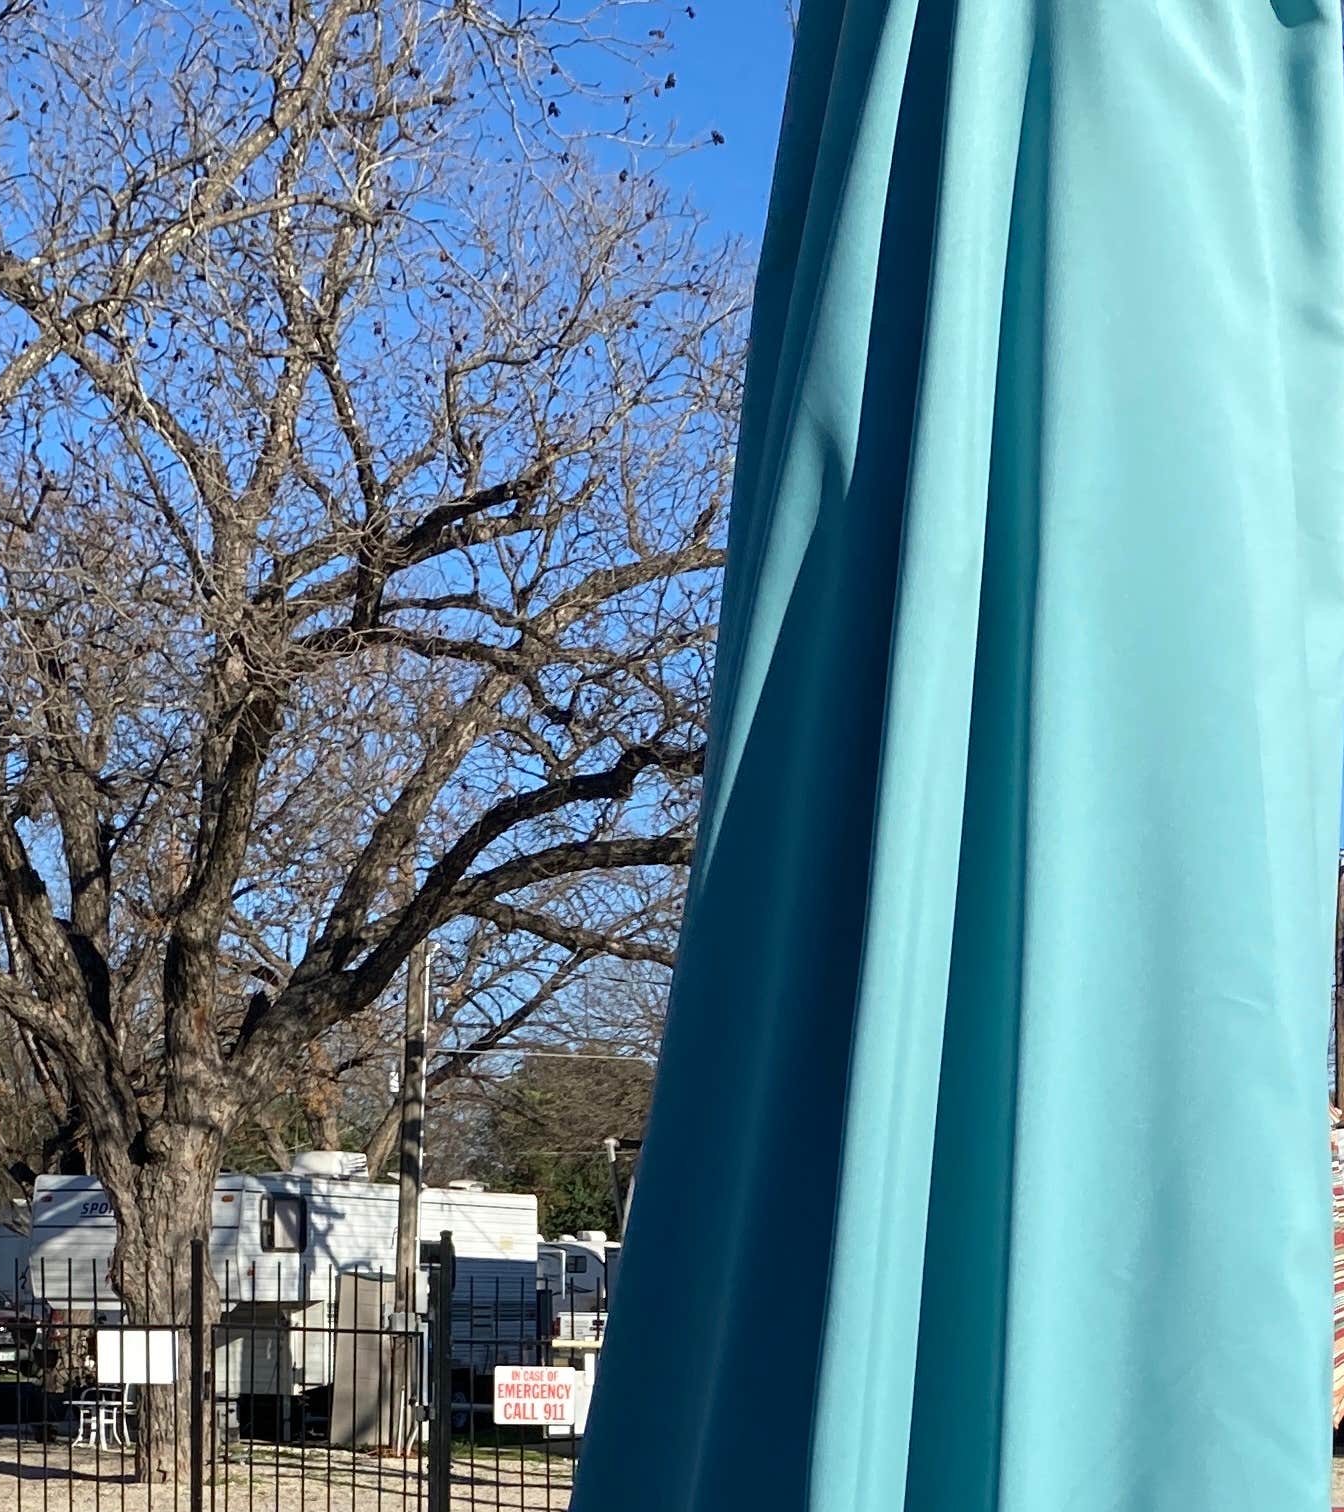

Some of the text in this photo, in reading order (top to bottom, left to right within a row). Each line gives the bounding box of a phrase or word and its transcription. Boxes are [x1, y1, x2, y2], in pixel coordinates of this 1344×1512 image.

[512, 1370, 559, 1381] IN CASE OF
[497, 1383, 572, 1400] EMERGENCY
[503, 1402, 565, 1420] CALL 911
